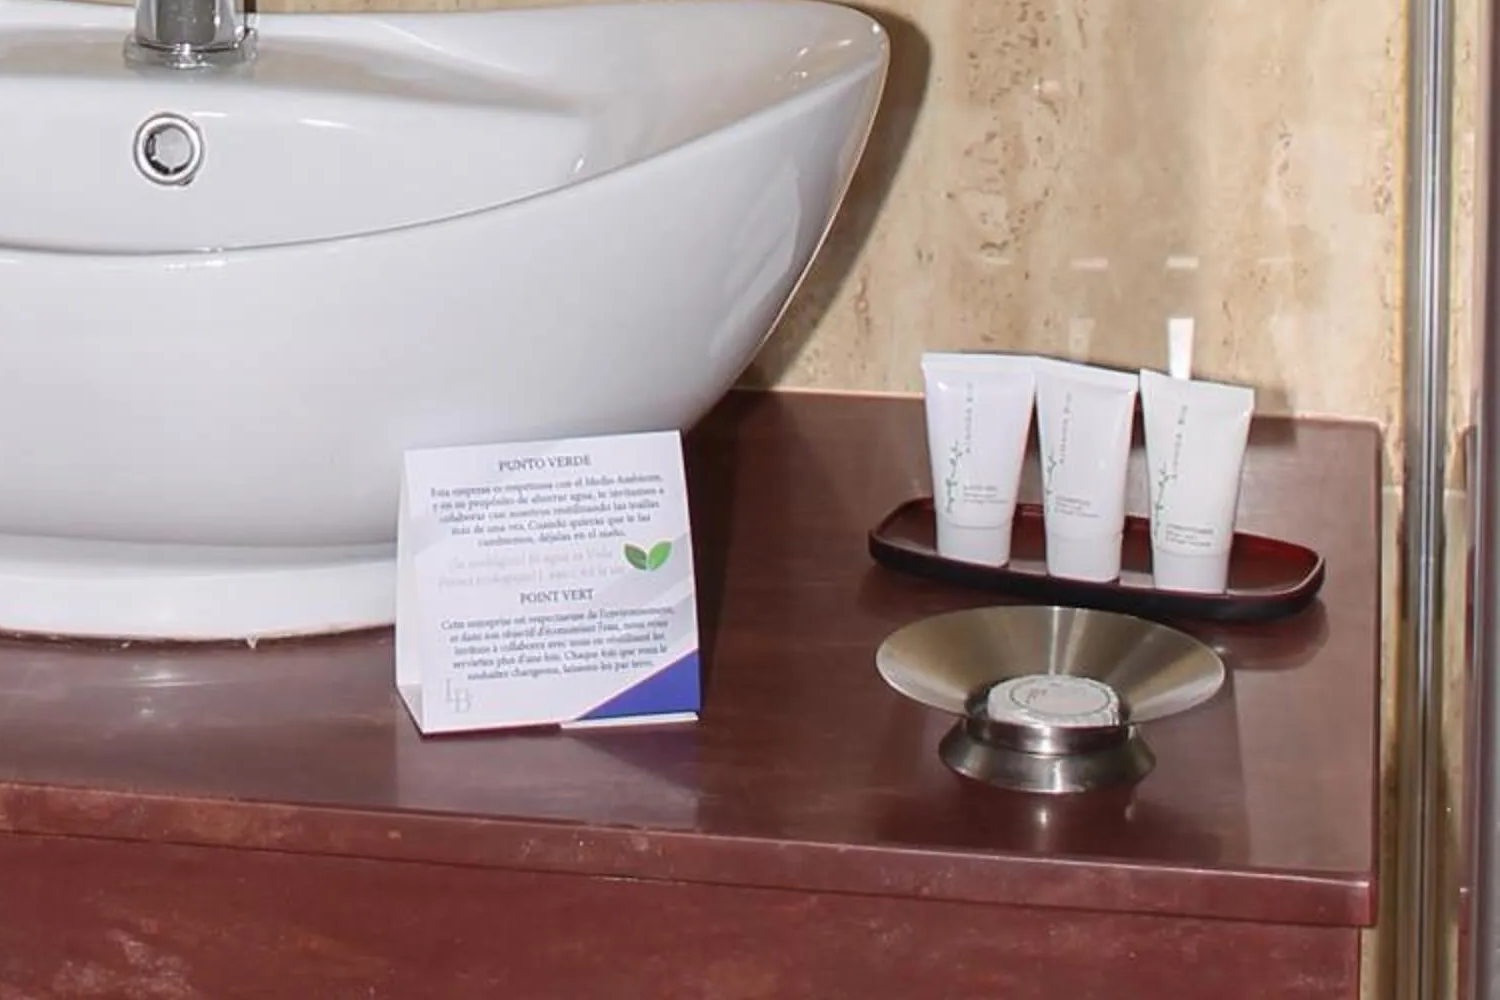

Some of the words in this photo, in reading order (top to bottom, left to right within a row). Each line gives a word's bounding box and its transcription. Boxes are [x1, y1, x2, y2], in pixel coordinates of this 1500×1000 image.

[499, 456, 545, 471] PUNTO
[547, 453, 591, 468] VERDE
[520, 590, 557, 604] POINT
[562, 588, 593, 601] VERT
